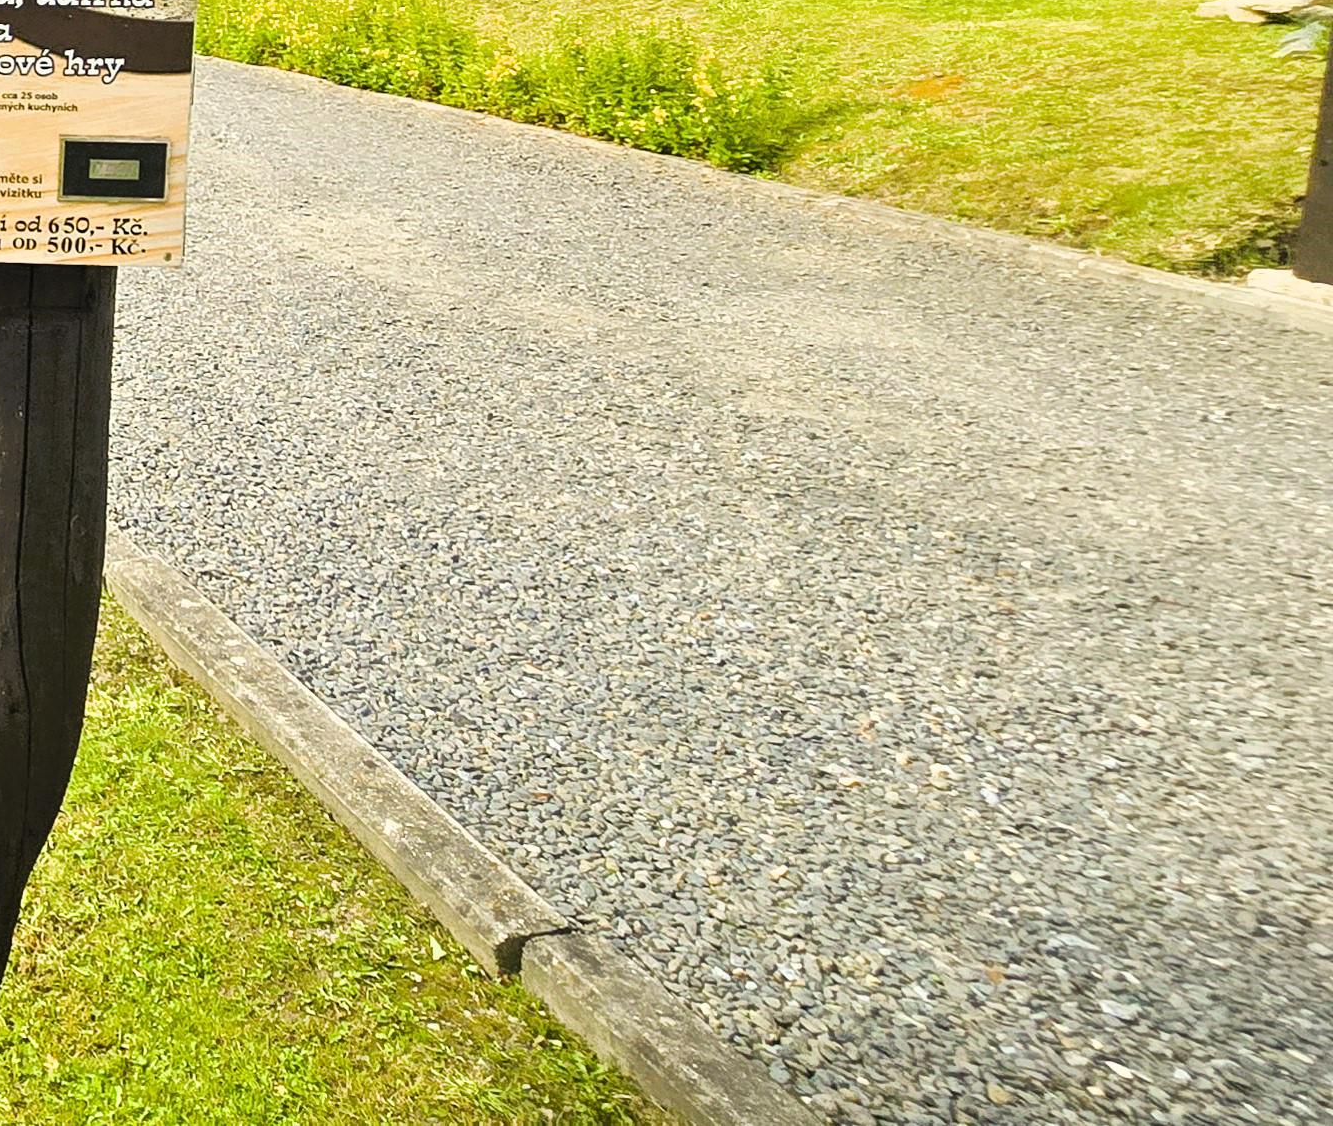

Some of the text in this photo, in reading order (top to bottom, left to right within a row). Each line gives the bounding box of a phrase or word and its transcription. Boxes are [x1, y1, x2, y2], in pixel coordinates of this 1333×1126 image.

[63, 49, 126, 84] hry
[20, 92, 33, 100] 25
[35, 92, 58, 100] osob
[27, 103, 78, 113] kuchyních
[32, 174, 43, 185] si
[0, 187, 42, 199] vizitku
[14, 216, 42, 232] od
[48, 217, 105, 236] 650,-
[112, 218, 149, 236] Kč.
[12, 237, 37, 250] OD
[47, 237, 103, 254] 500,-
[111, 238, 147, 255] Kč.
